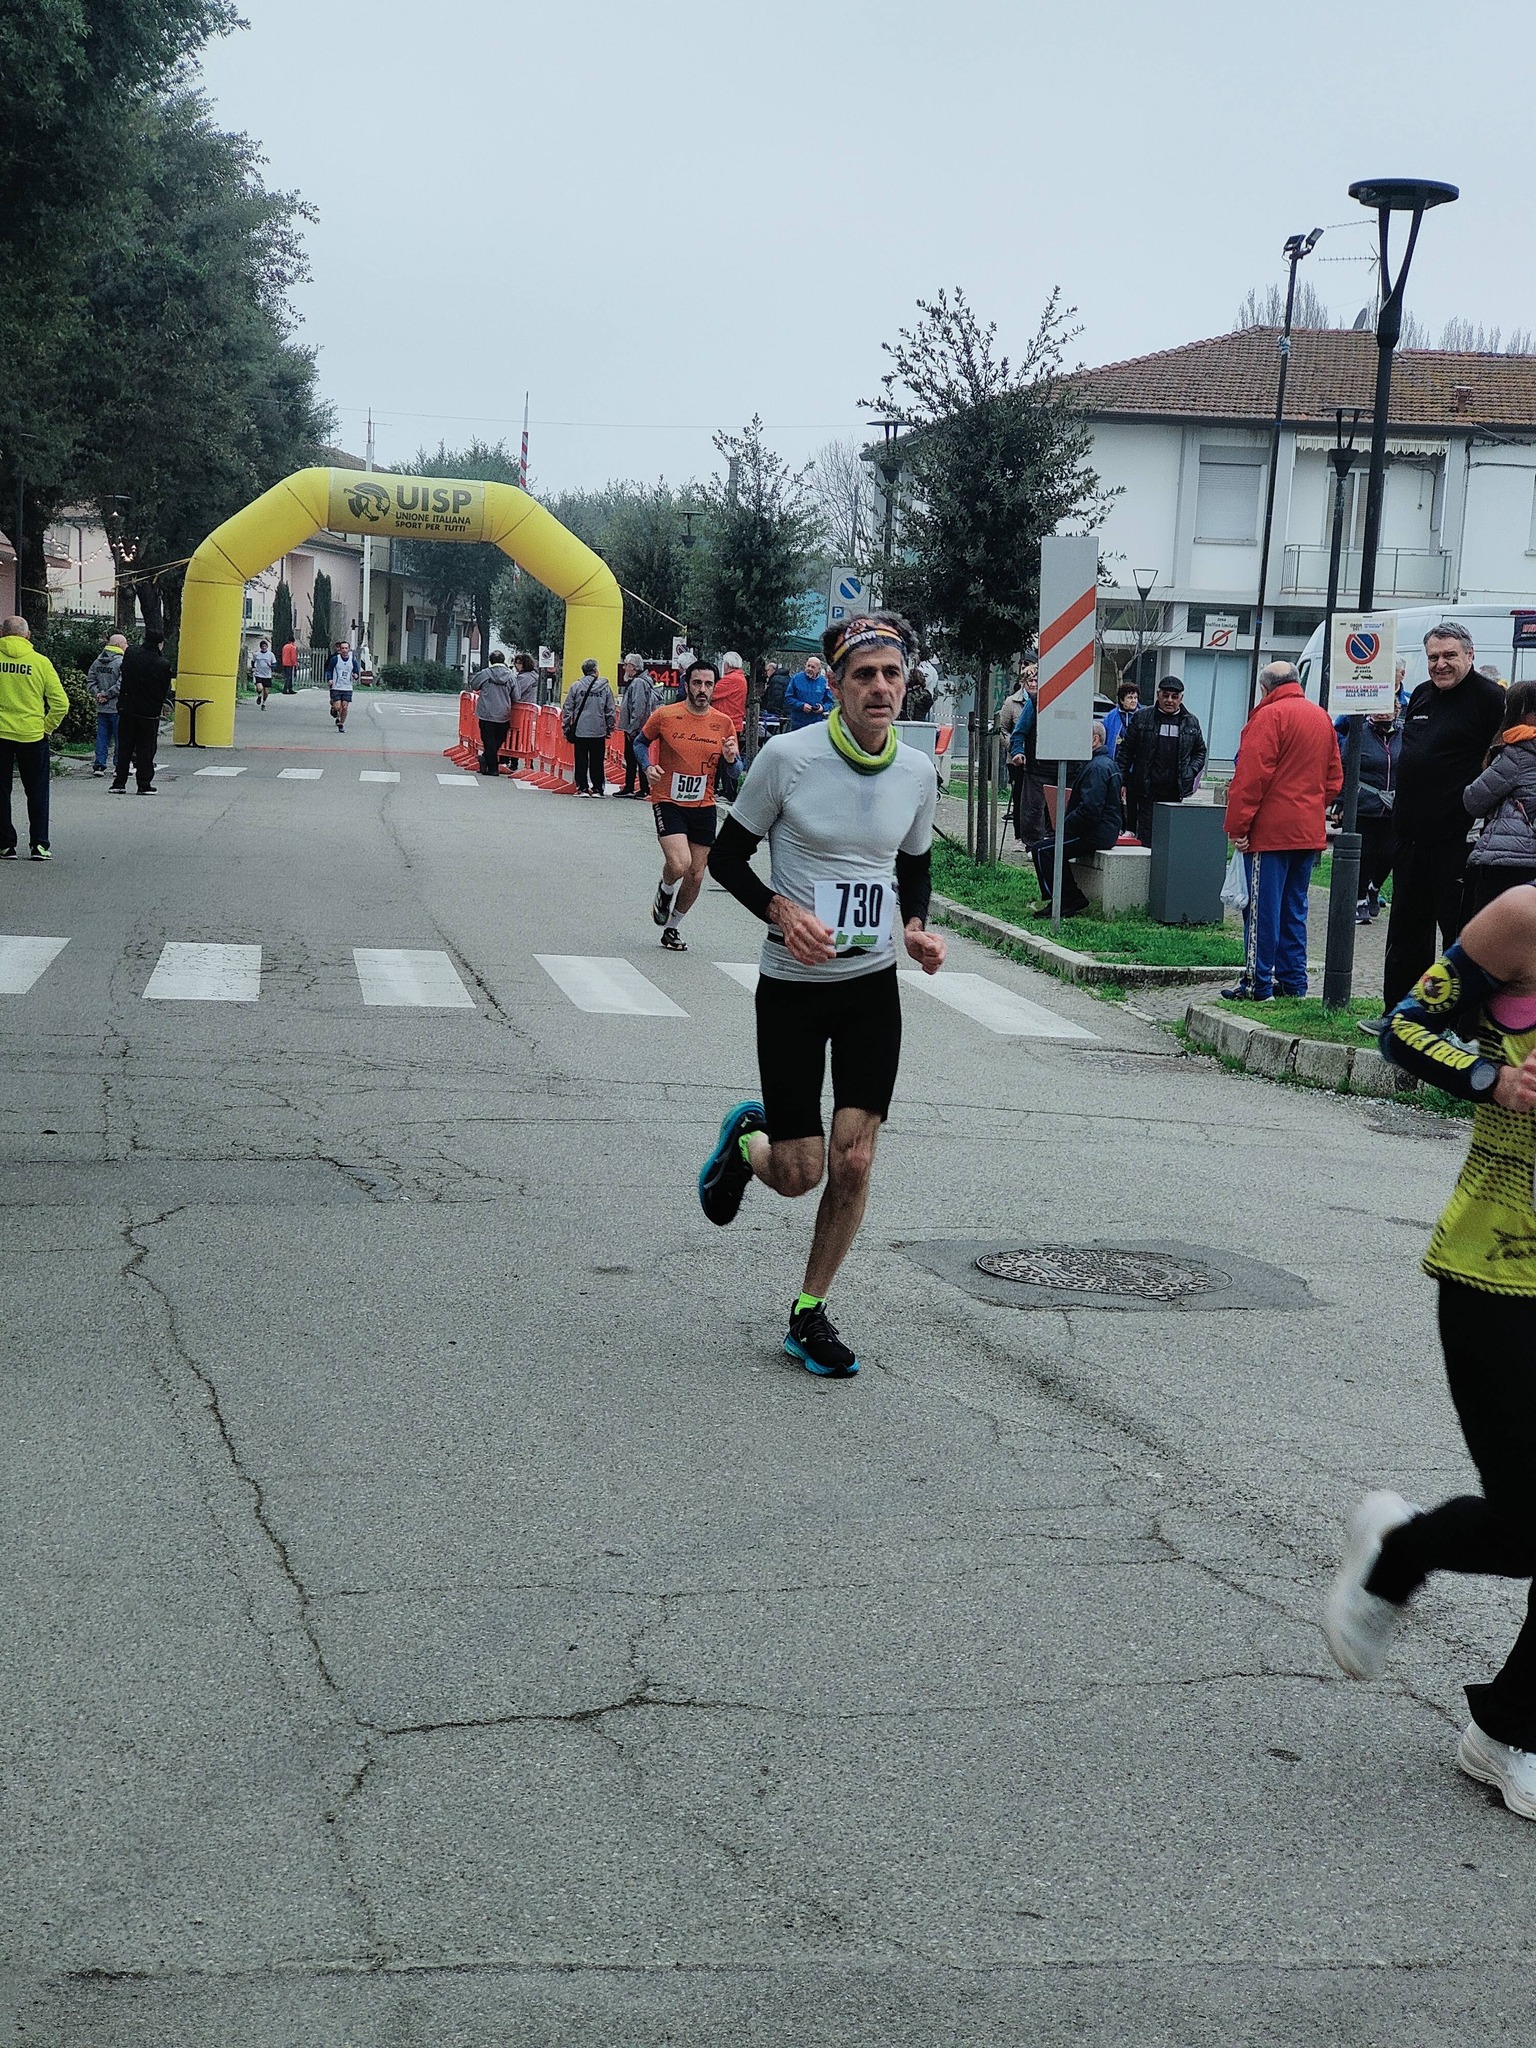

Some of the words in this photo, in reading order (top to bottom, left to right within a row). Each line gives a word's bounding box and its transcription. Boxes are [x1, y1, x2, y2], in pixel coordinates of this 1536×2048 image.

[396, 484, 472, 514] UISP
[395, 511, 430, 523] UNIONE
[432, 514, 471, 526] ITALIANA
[395, 521, 422, 530] SPORT
[444, 525, 466, 533] TUTTI
[677, 775, 701, 793] 502
[836, 883, 883, 928] 730
